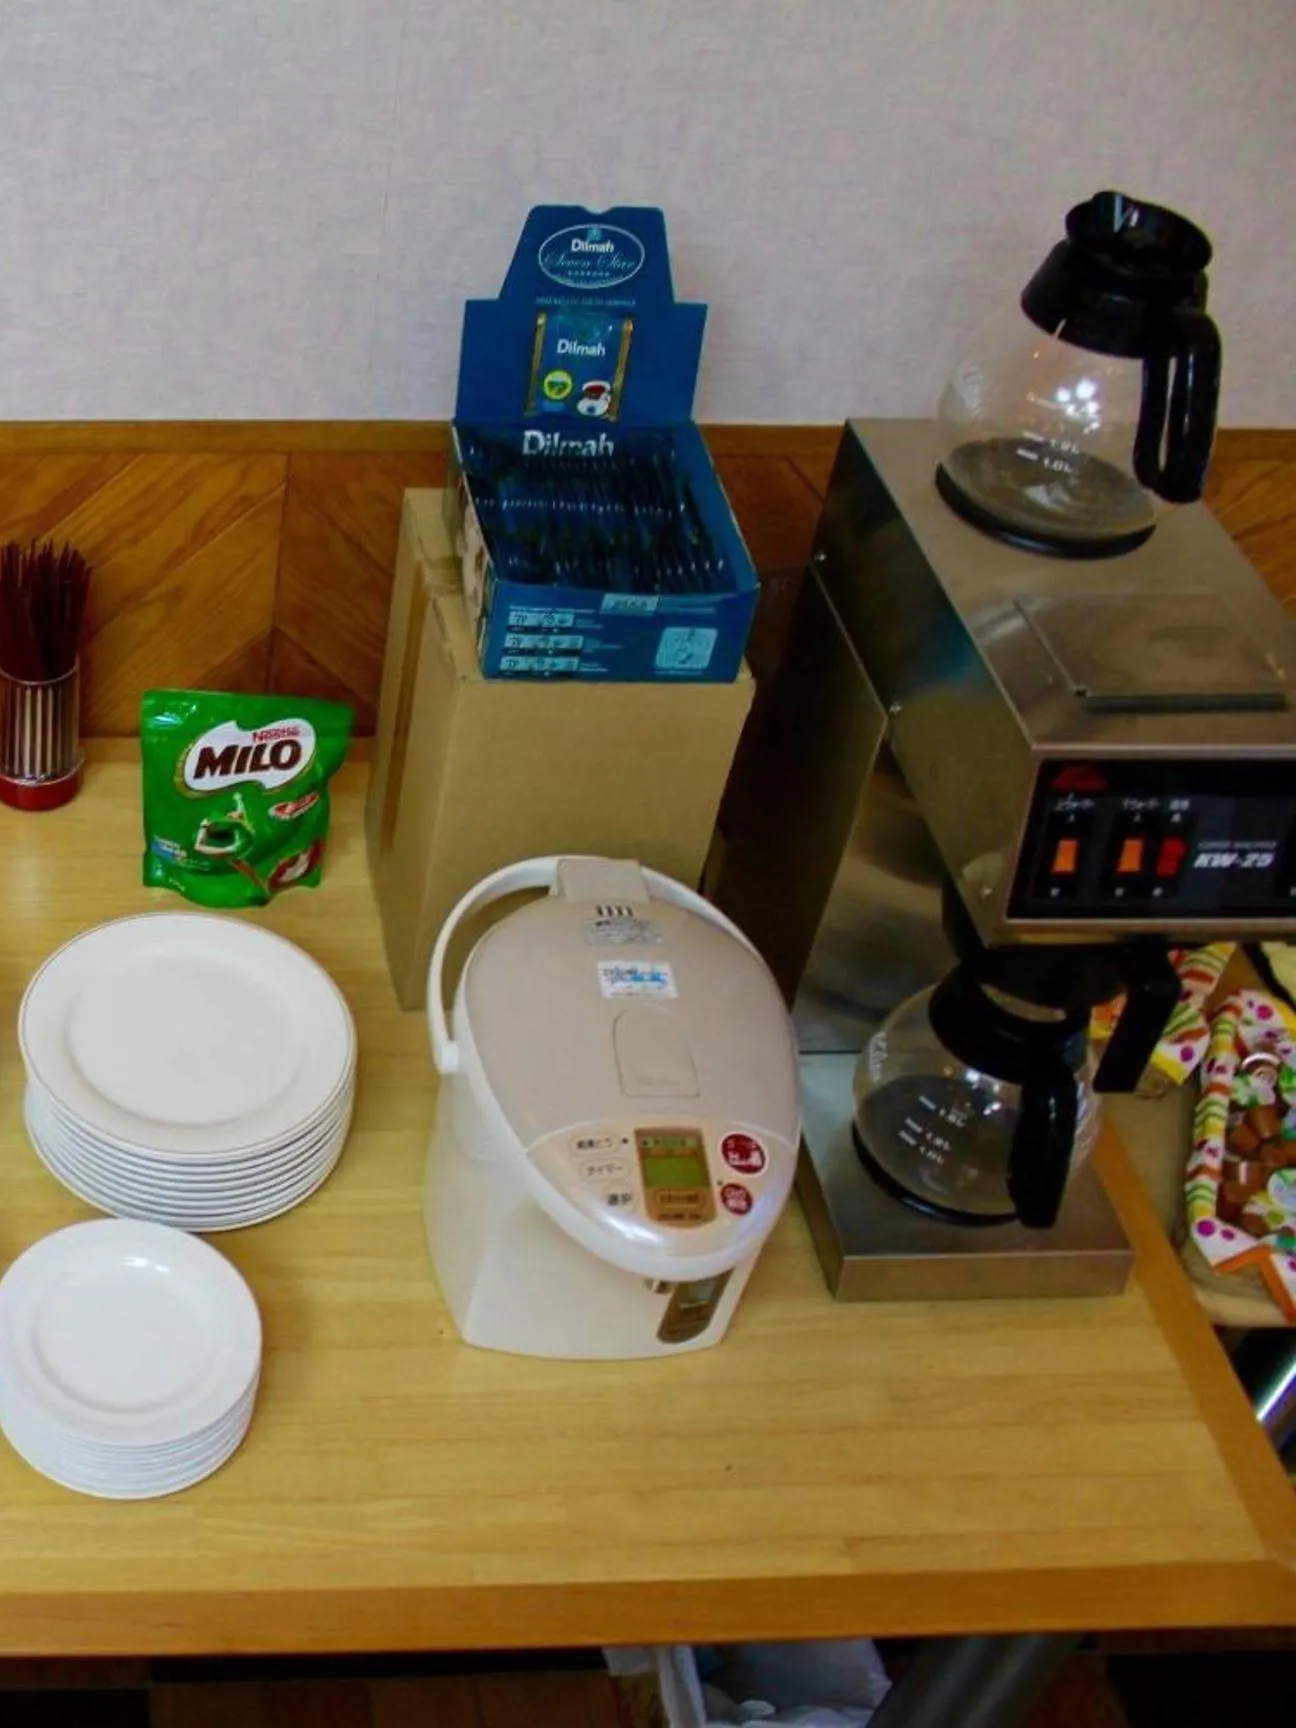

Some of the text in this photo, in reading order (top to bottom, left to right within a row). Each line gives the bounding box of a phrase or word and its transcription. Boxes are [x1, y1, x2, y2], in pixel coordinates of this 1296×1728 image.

[571, 238, 615, 253] Dilmah
[557, 338, 606, 357] Dilmah
[193, 739, 303, 780] MILO
